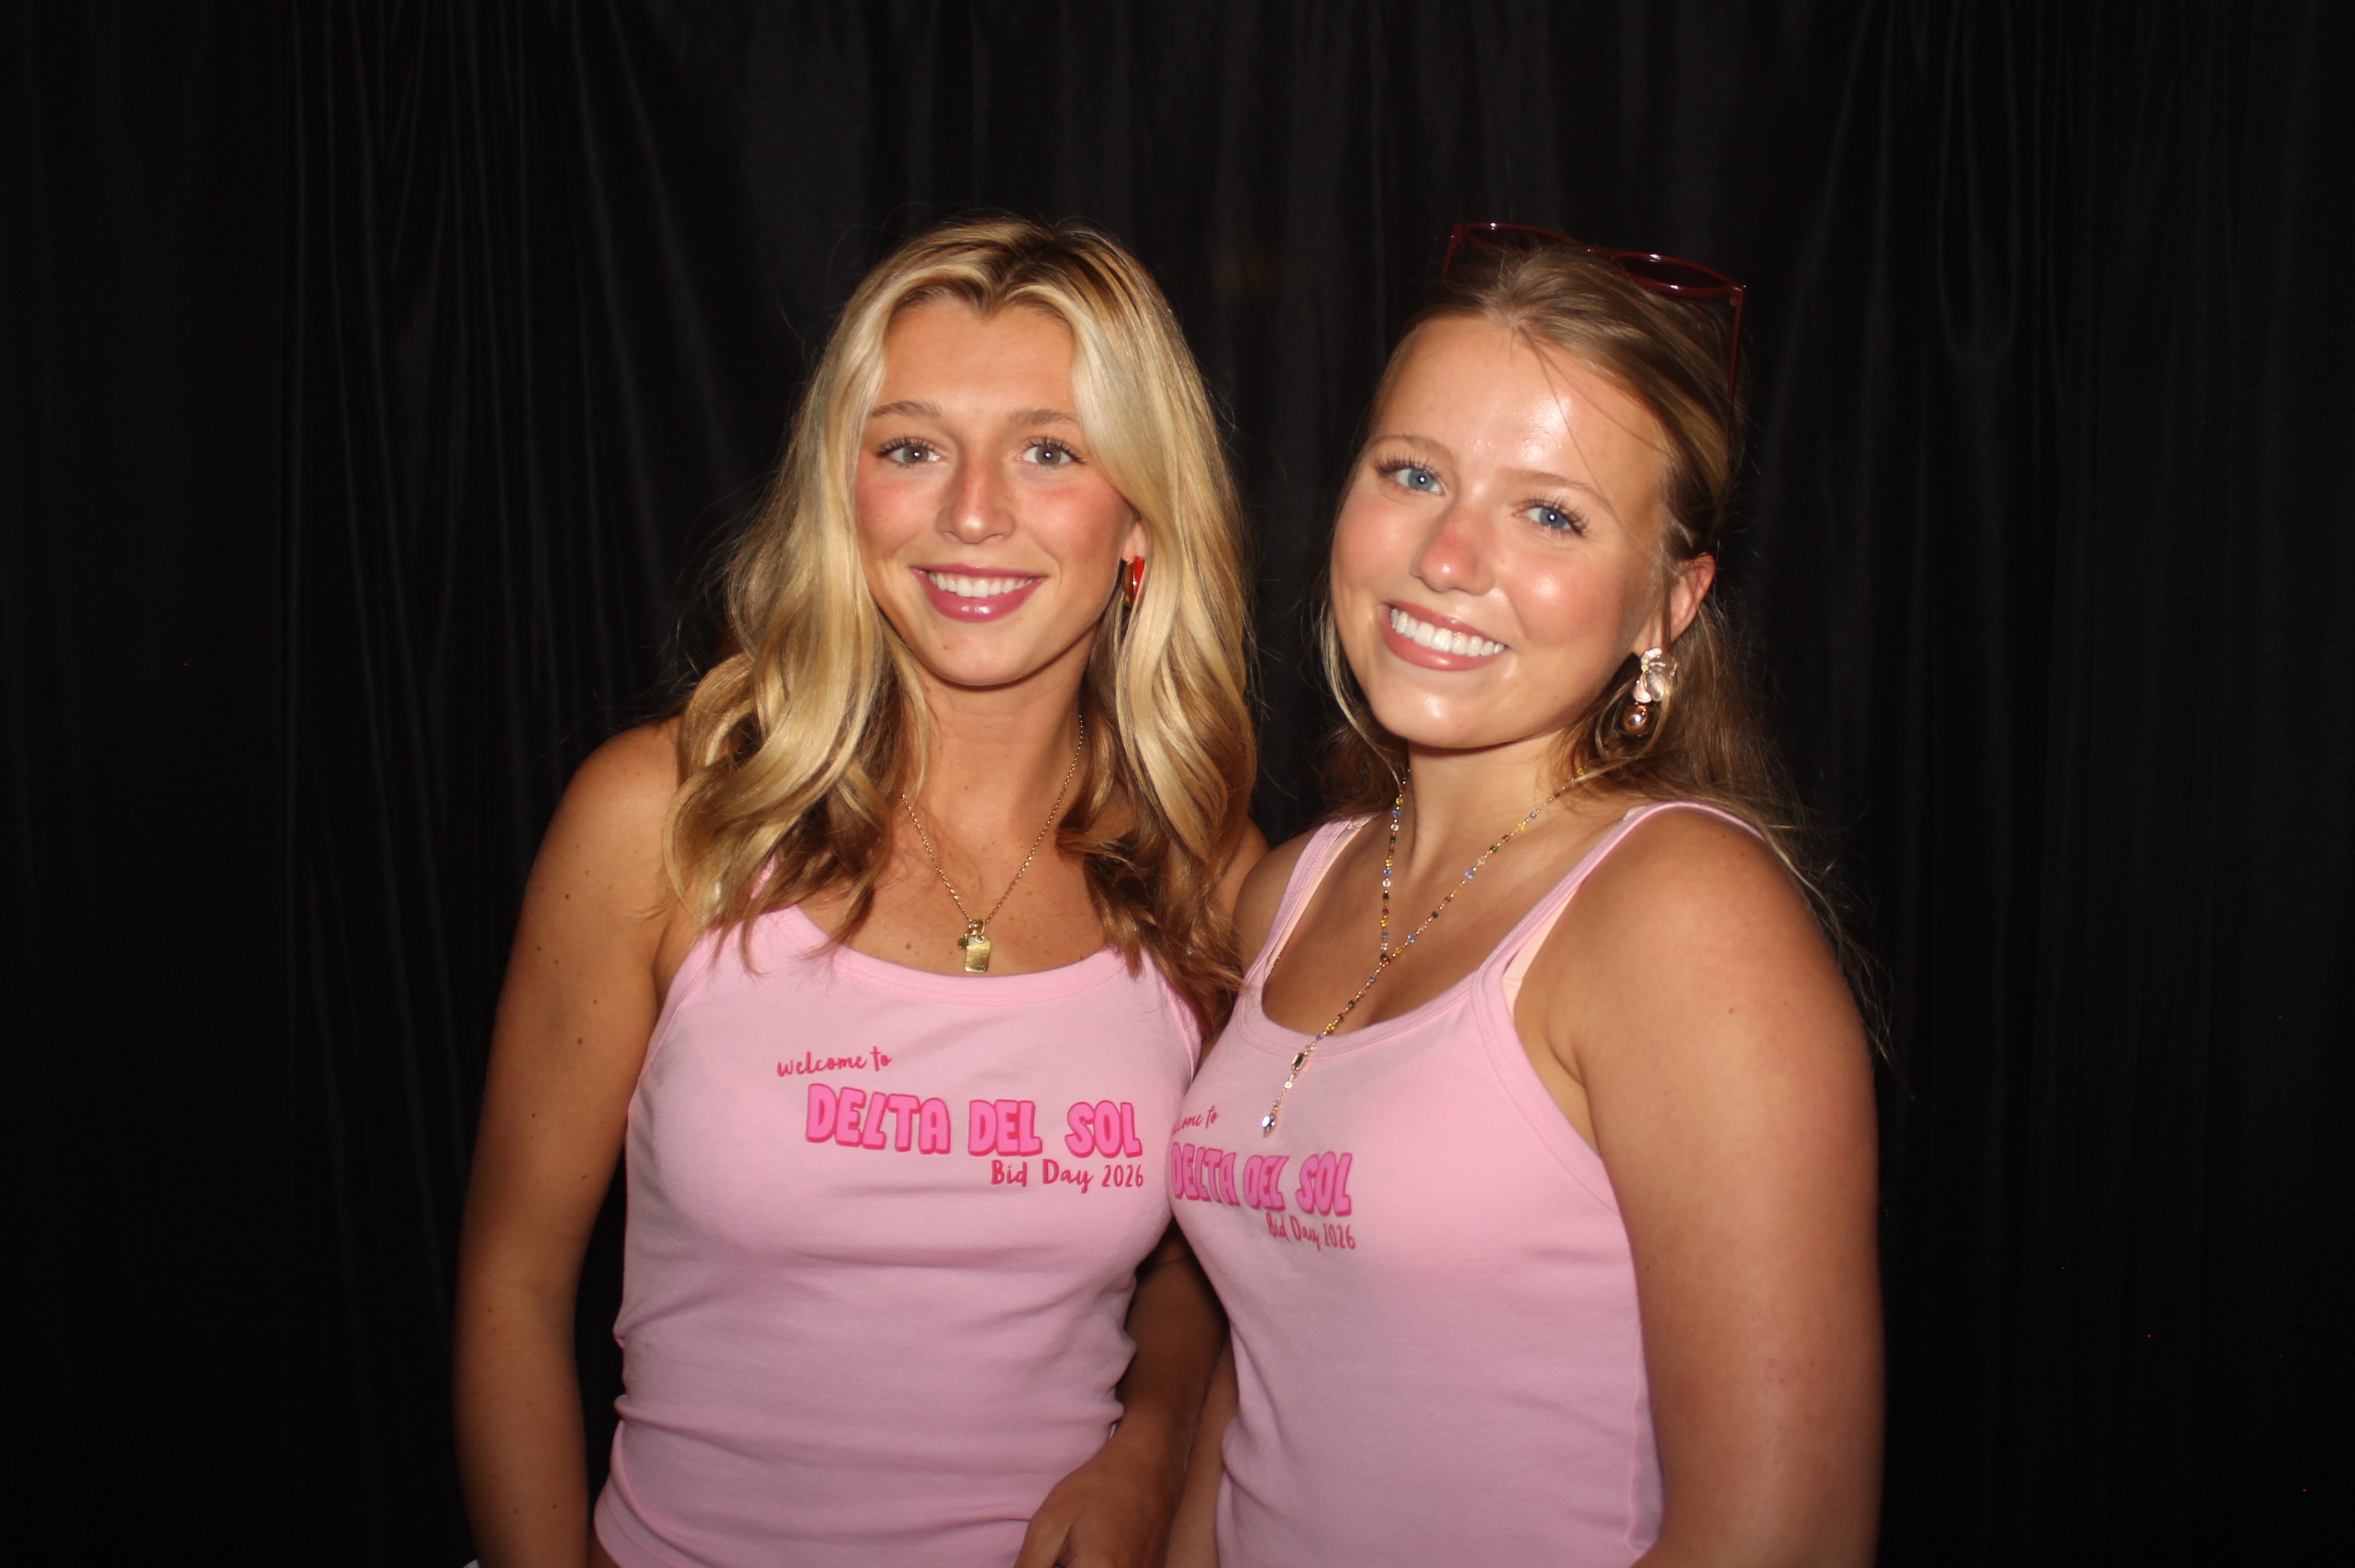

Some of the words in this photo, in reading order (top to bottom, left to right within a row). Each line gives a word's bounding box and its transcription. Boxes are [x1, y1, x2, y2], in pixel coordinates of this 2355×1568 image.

[777, 1051, 866, 1077] welcome
[869, 1046, 892, 1072] to
[805, 1083, 951, 1155] DELTA
[968, 1099, 1043, 1157] DEL
[1065, 1100, 1142, 1158] SOL
[1205, 1105, 1219, 1129] to
[991, 1159, 1027, 1187] Bid
[1042, 1158, 1093, 1194] Day
[1101, 1164, 1144, 1188] 2026
[1171, 1142, 1241, 1207] DELTA
[1242, 1155, 1290, 1211] DEL
[1295, 1151, 1352, 1216] SOL
[1265, 1211, 1290, 1242] Bid
[1289, 1215, 1321, 1252] Day
[1322, 1223, 1356, 1249] 2026
